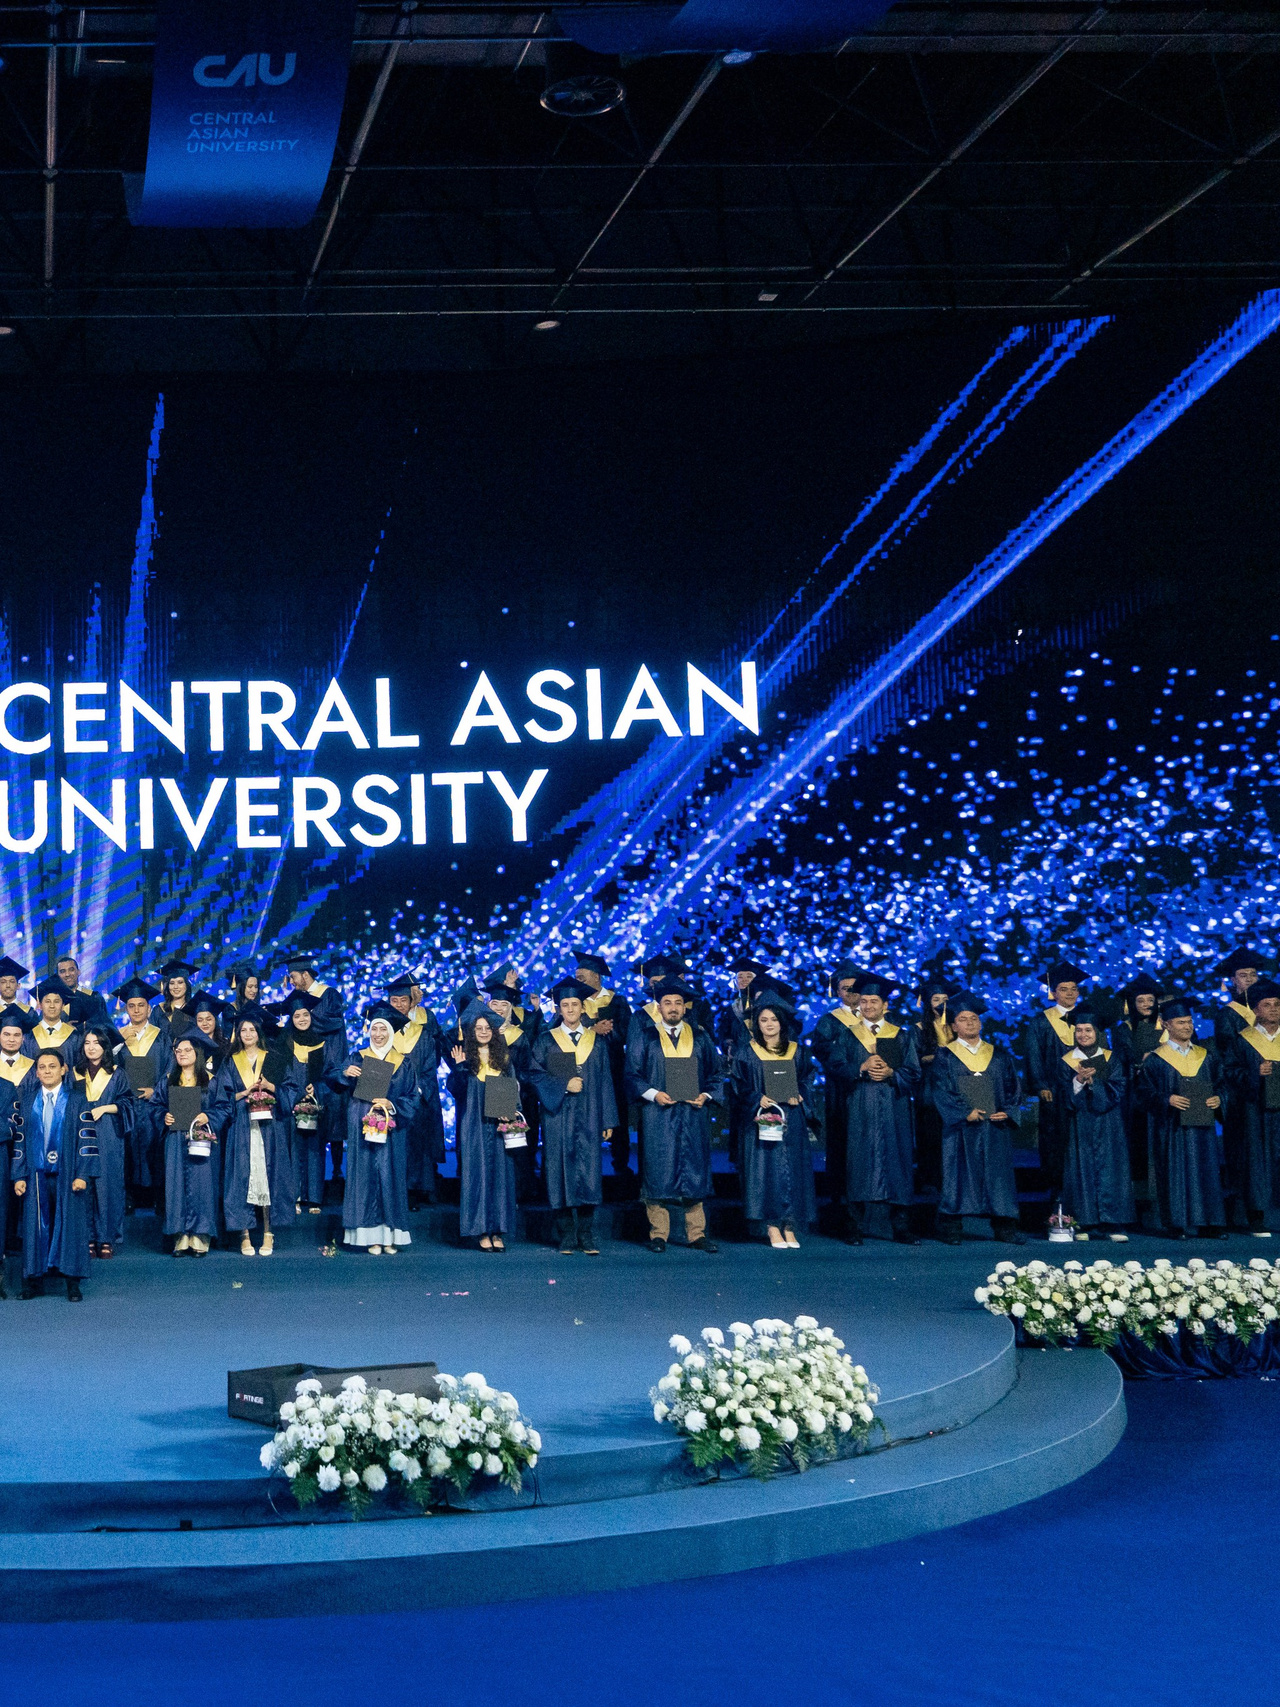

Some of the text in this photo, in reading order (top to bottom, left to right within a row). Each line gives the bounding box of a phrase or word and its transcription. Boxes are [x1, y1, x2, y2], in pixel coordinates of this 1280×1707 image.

[193, 52, 297, 88] CAU
[189, 111, 277, 125] CENTRAL
[187, 127, 249, 140] ASIAN
[186, 139, 299, 153] UNIVERSITY
[450, 661, 759, 746] ASIAN
